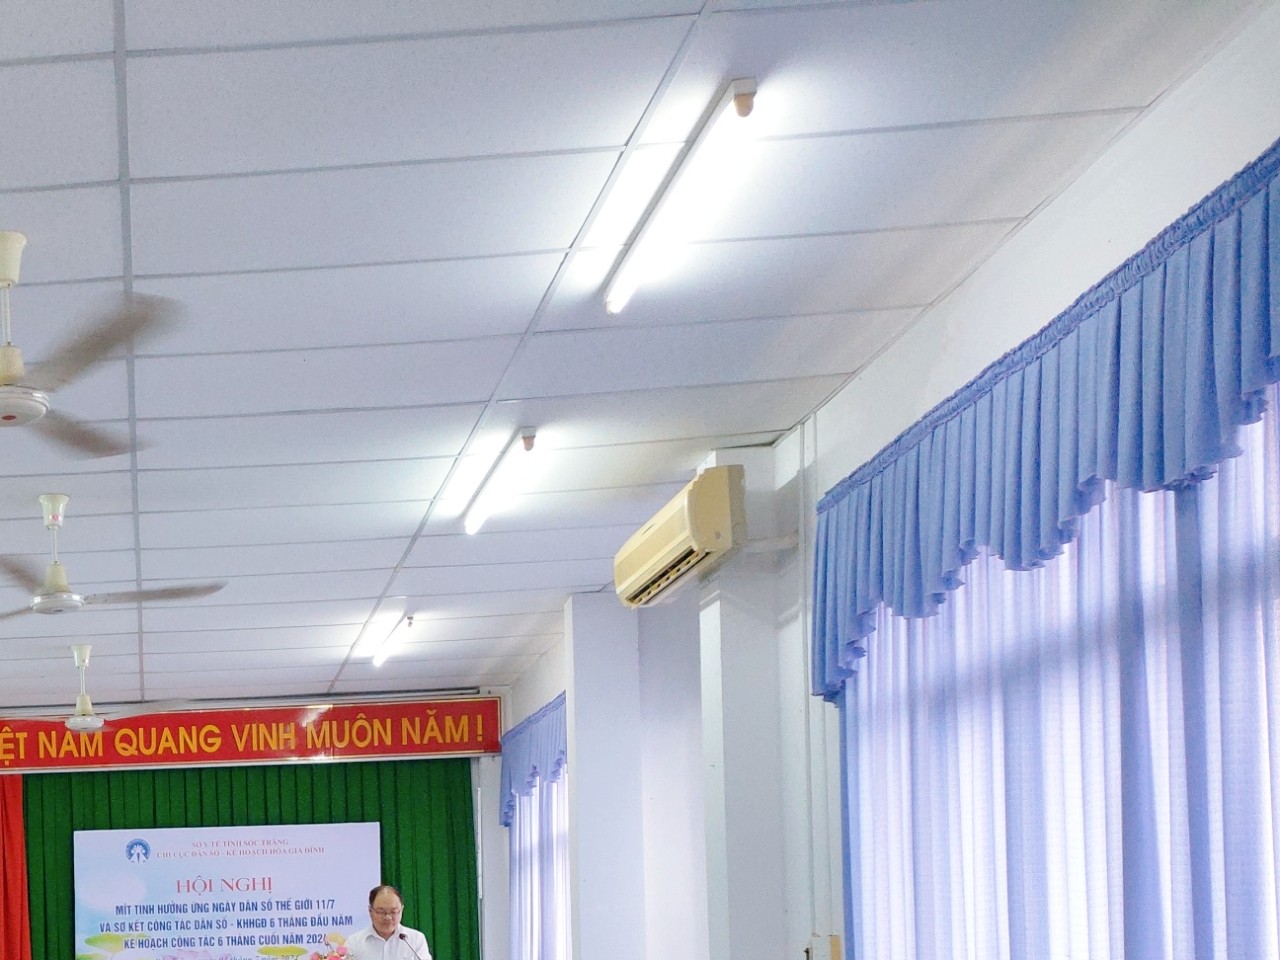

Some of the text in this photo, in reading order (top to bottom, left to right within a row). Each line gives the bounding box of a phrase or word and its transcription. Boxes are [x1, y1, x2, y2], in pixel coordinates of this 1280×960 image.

[39, 731, 103, 758] NAM
[114, 725, 222, 757] QUANG
[231, 722, 296, 752] VINH
[306, 713, 392, 750] MUÔN
[176, 875, 272, 896] HỘI NGHỊ
[134, 904, 155, 915] TINH
[157, 900, 188, 914] HƯỞNG
[212, 899, 236, 913] NGÀY
[239, 899, 258, 912] DÂN
[261, 897, 273, 911] SỐ
[275, 897, 292, 911] THẾ
[294, 897, 313, 910] GIỚI
[315, 899, 335, 910] 11/7
[99, 920, 111, 932] VÀ
[114, 921, 126, 932] SƠ
[128, 919, 144, 932] KẾT
[147, 918, 172, 931] CÔNG
[174, 917, 191, 930] TÁC
[194, 918, 213, 930] DÂN
[215, 915, 228, 929] SỐ
[269, 918, 275, 928] 6
[278, 914, 308, 927] THÁNG
[310, 912, 329, 927] ĐẦU
[331, 914, 353, 926] NĂM
[138, 937, 168, 951] HOẠCH
[171, 935, 196, 948] CÔNG
[198, 934, 215, 947] TÁC
[217, 936, 223, 946] 6
[225, 932, 256, 946] THÁNG
[258, 931, 280, 945] CUỐI
[282, 932, 304, 945] NĂM
